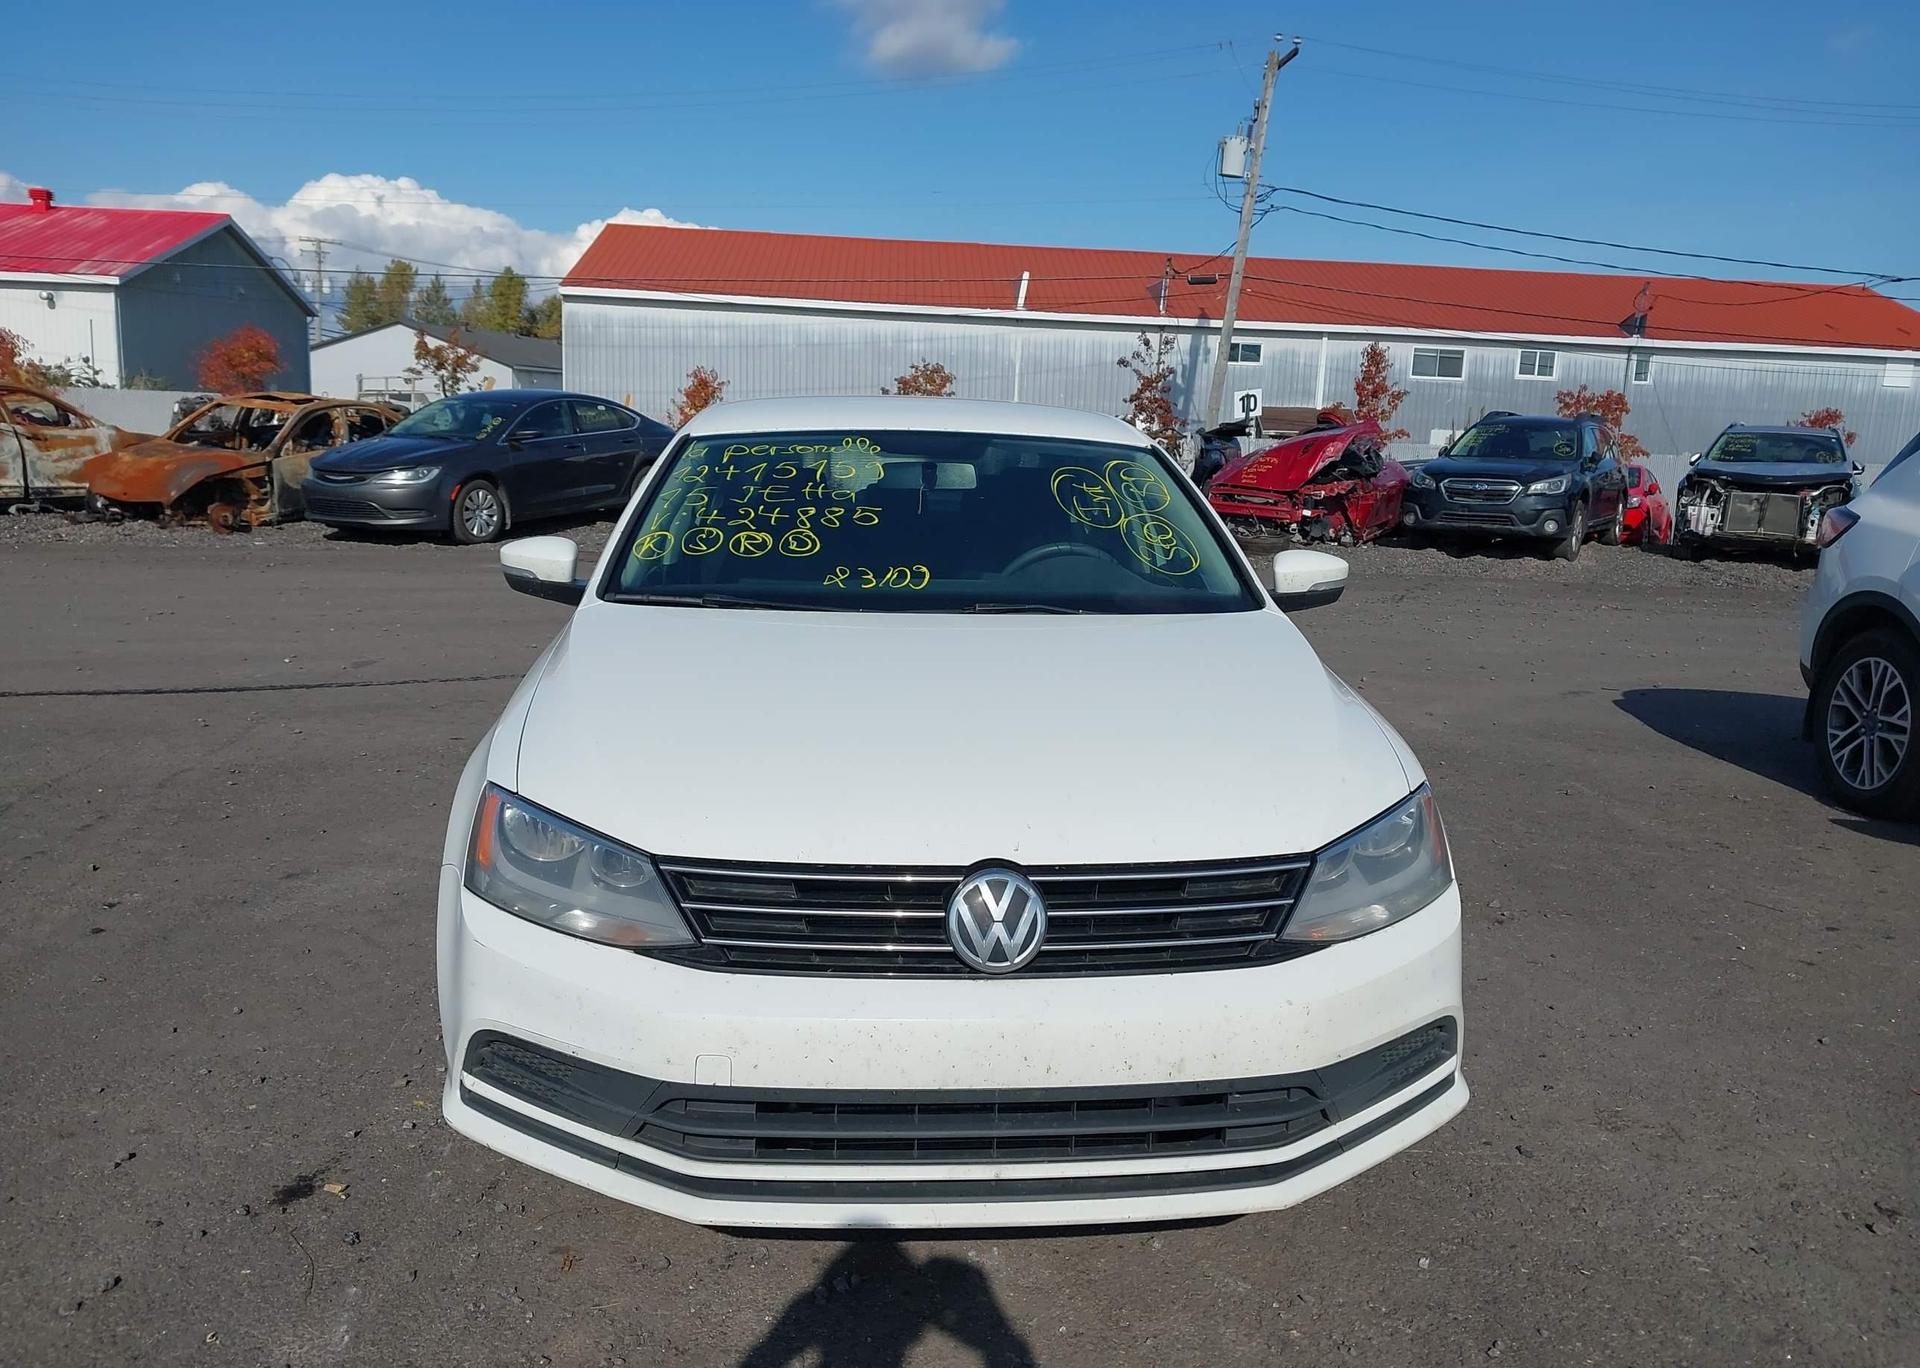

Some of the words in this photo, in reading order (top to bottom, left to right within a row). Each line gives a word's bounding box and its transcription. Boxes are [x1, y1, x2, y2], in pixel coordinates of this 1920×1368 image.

[1238, 393, 1258, 414] 10
[659, 485, 720, 509] 15
[694, 504, 883, 530] 424885
